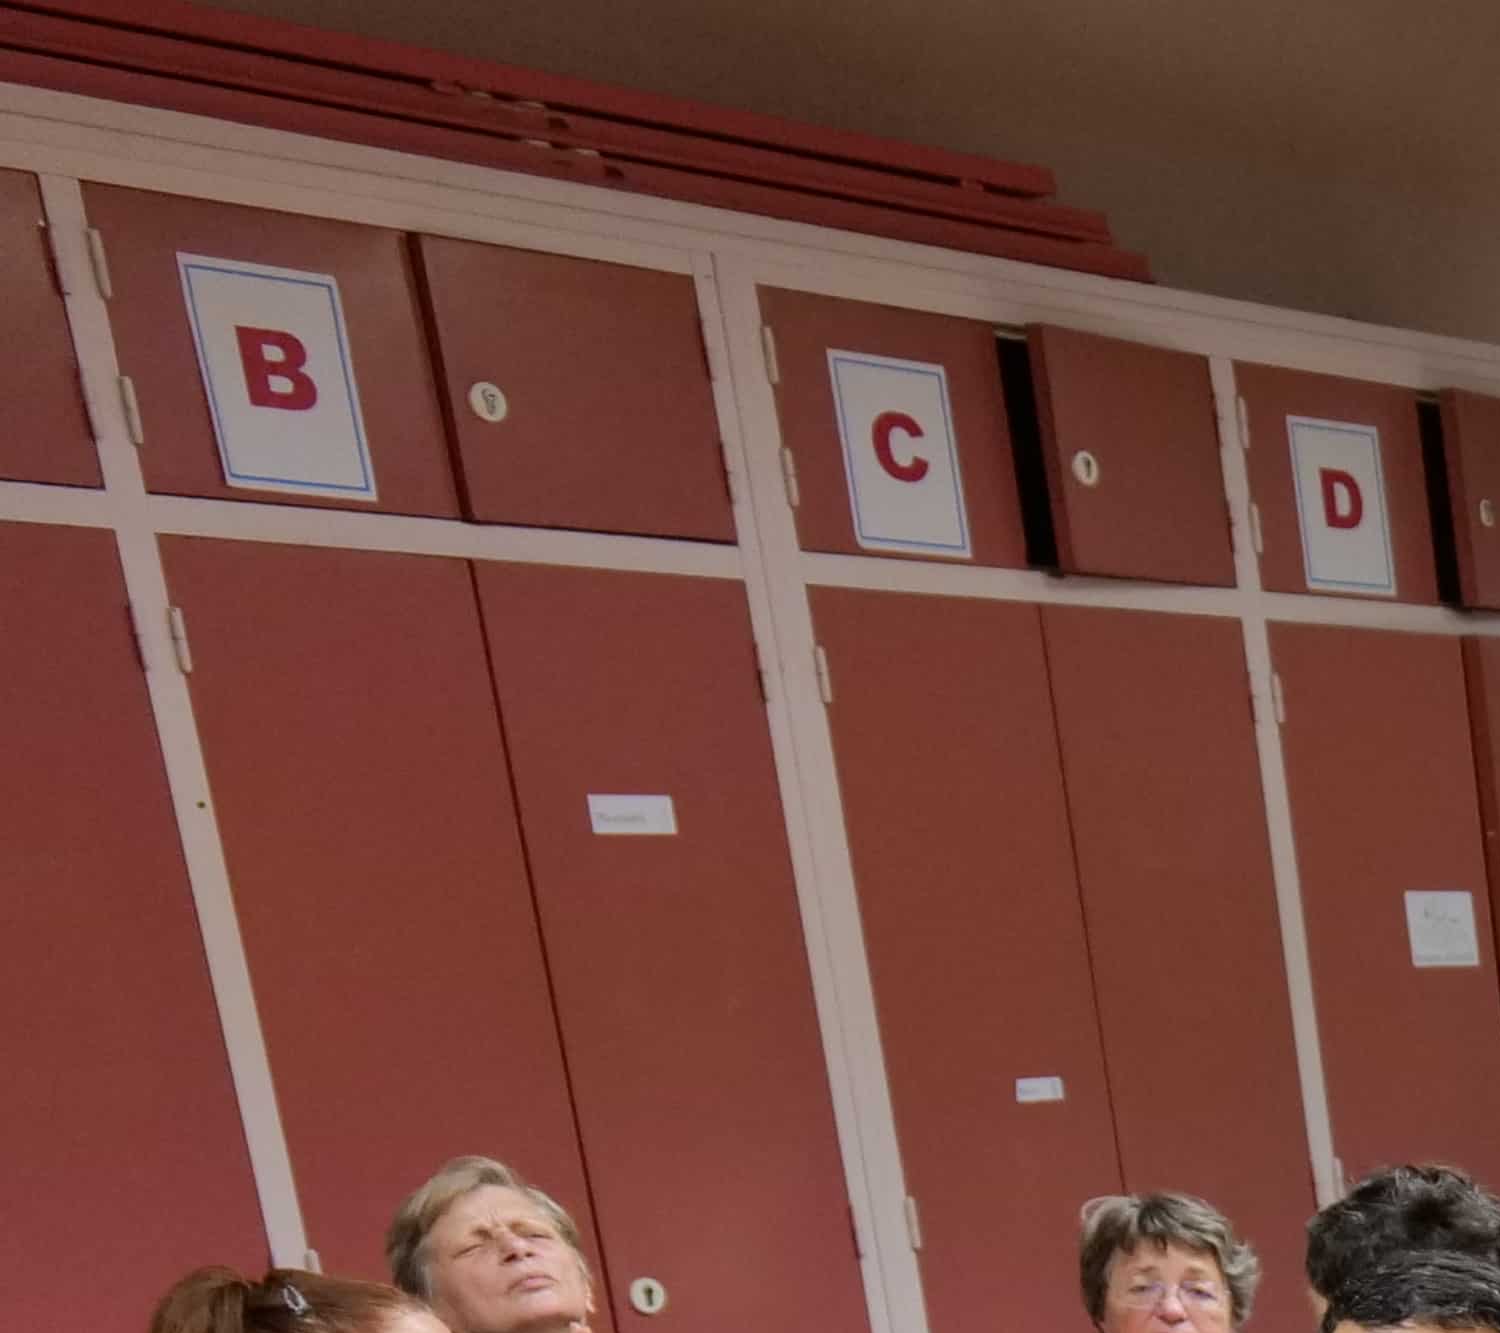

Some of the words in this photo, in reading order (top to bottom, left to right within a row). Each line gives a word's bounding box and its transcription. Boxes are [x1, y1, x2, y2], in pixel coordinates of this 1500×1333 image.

[236, 325, 319, 412] B
[872, 412, 930, 483] C
[1321, 470, 1363, 529] D
